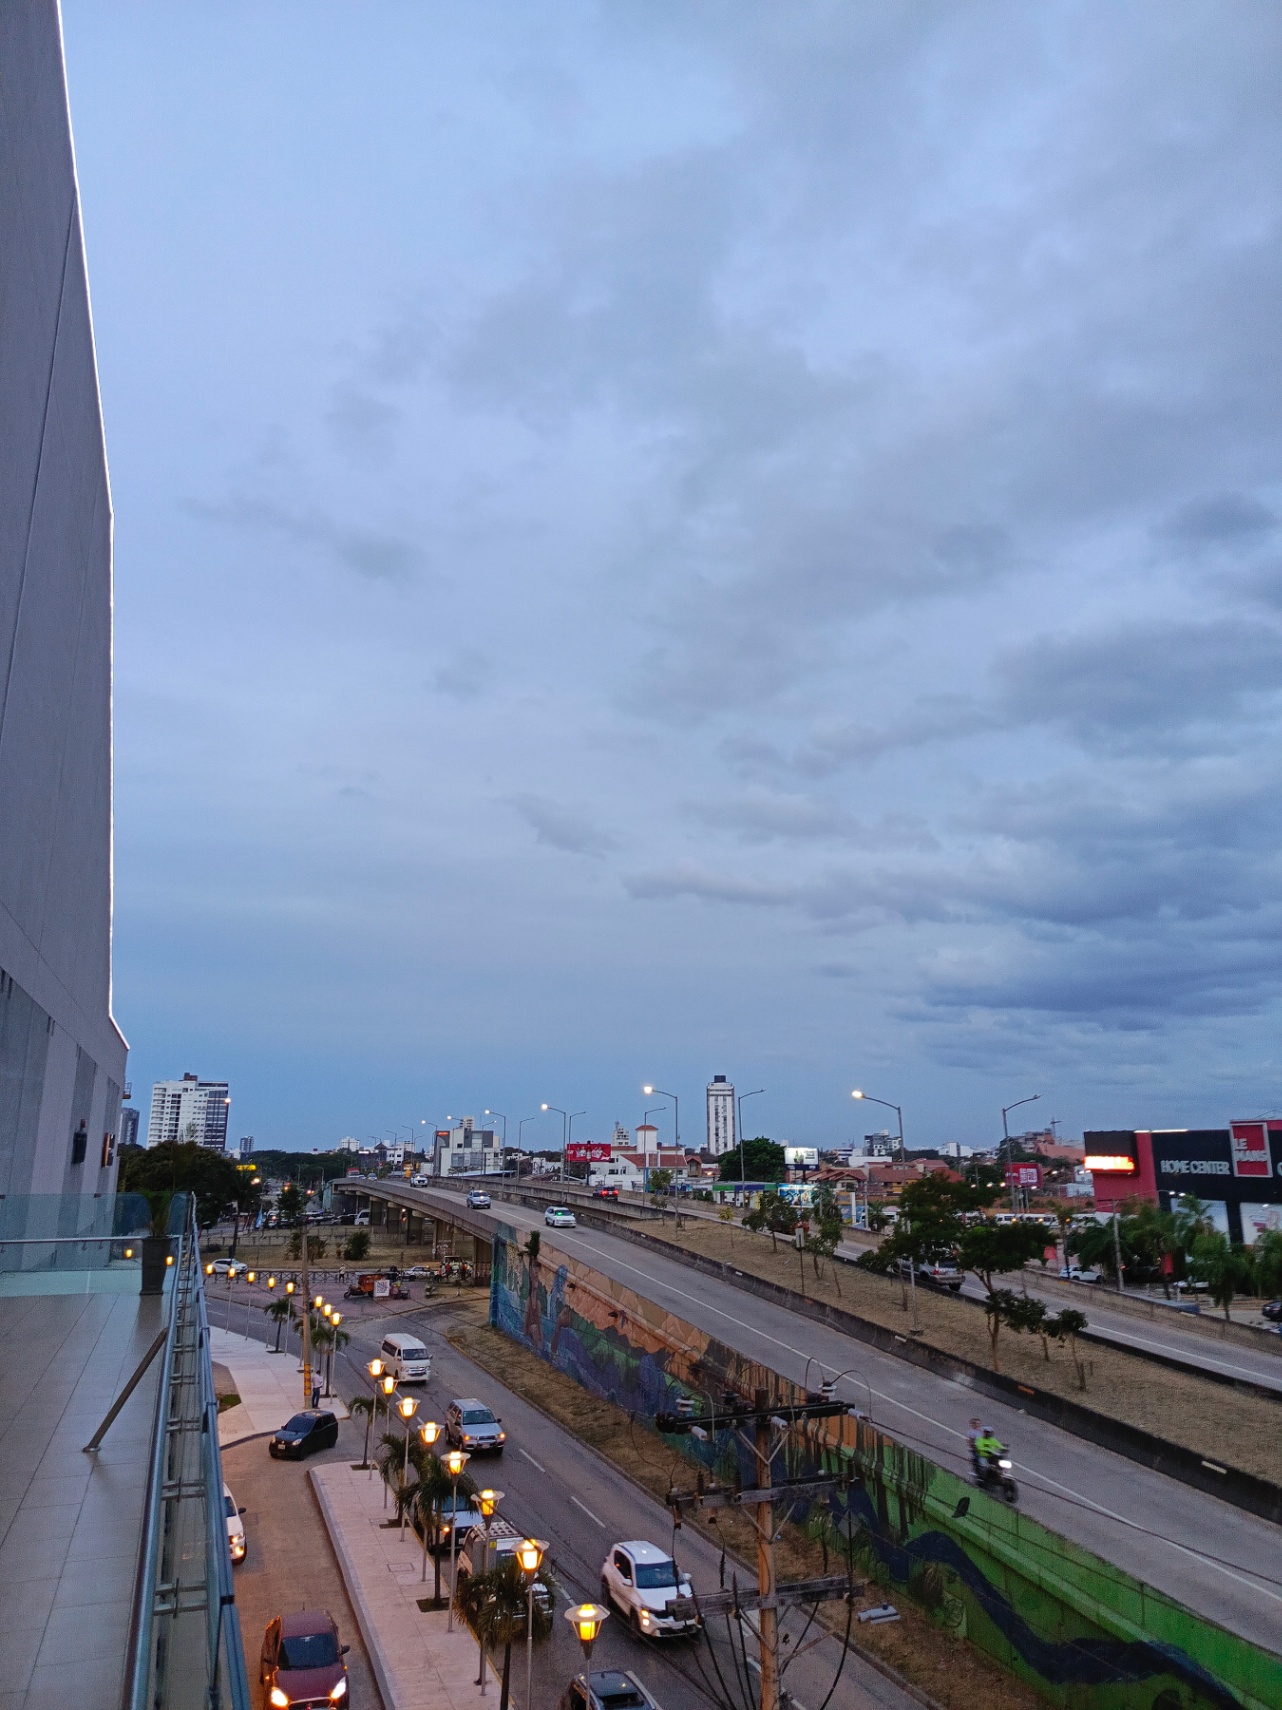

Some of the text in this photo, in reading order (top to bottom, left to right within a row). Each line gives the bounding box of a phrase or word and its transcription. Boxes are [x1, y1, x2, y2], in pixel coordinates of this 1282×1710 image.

[1234, 1138, 1247, 1150] LE
[1160, 1160, 1230, 1175] HOME CENTER
